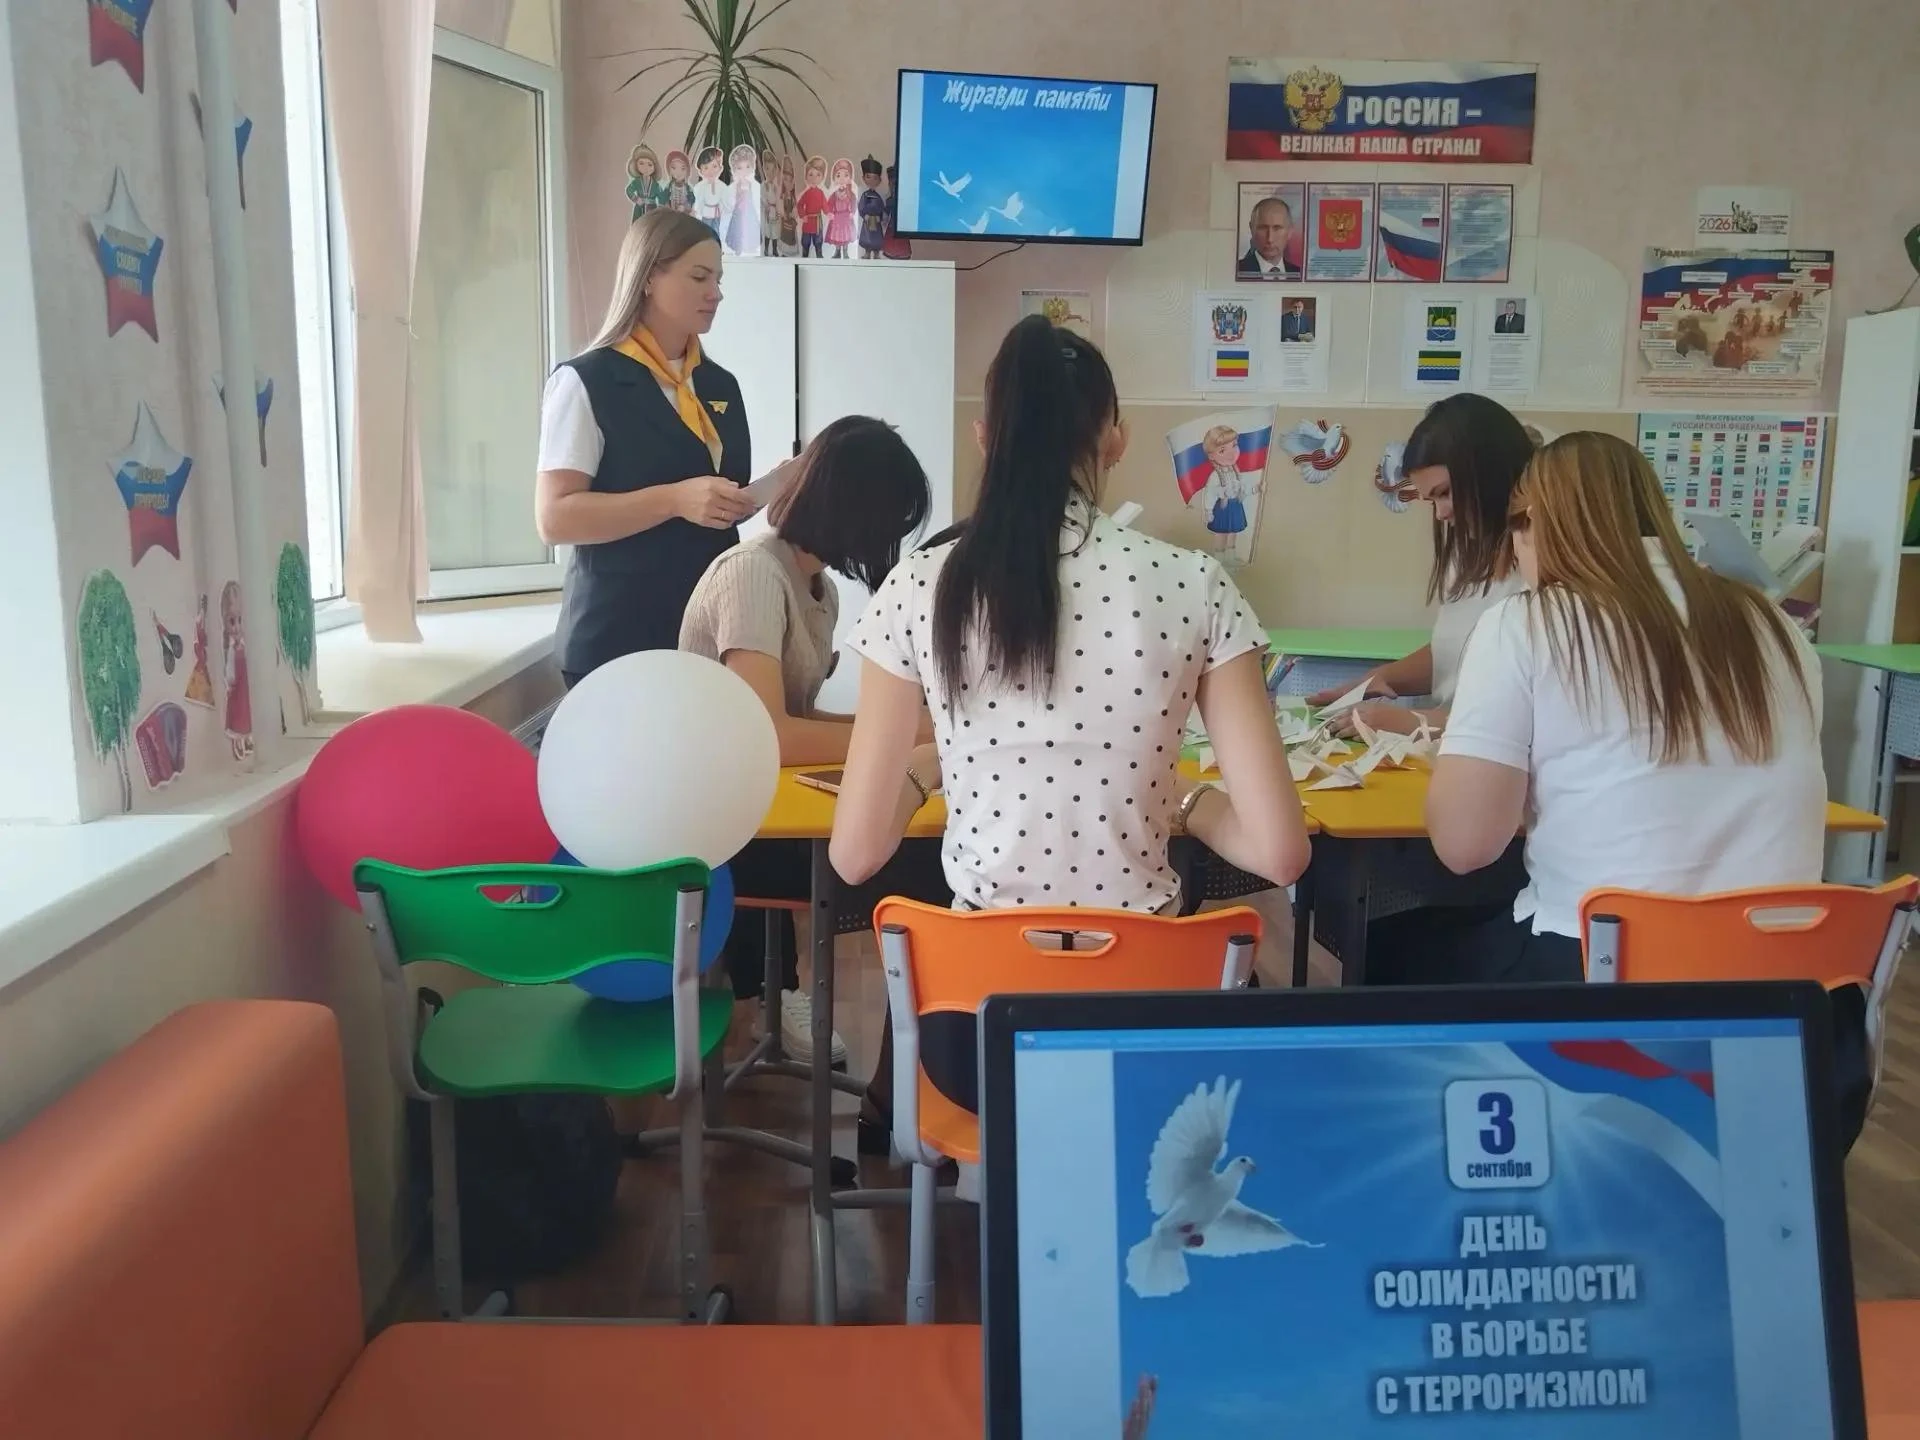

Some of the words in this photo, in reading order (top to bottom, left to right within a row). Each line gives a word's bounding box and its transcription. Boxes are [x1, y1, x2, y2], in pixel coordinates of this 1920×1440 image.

[943, 80, 1029, 112] Журавли
[1033, 87, 1112, 111] памяти
[1346, 96, 1460, 126] РОССИЯ
[1280, 135, 1355, 154] ВЕЛИКАЯ
[1359, 137, 1408, 155] НАША
[1412, 138, 1481, 155] СТРАНА!
[1478, 1092, 1516, 1155] 3
[1467, 1160, 1532, 1179] сентября
[1460, 1214, 1546, 1257] ДЕНЬ
[1374, 1264, 1637, 1310] СОЛИДАРНОСТИ
[1432, 1322, 1454, 1359] В
[1461, 1317, 1588, 1358] БОРЬБЕ
[1376, 1377, 1398, 1414] С
[1405, 1368, 1647, 1413] ТЕРРОРИЗМОМ
